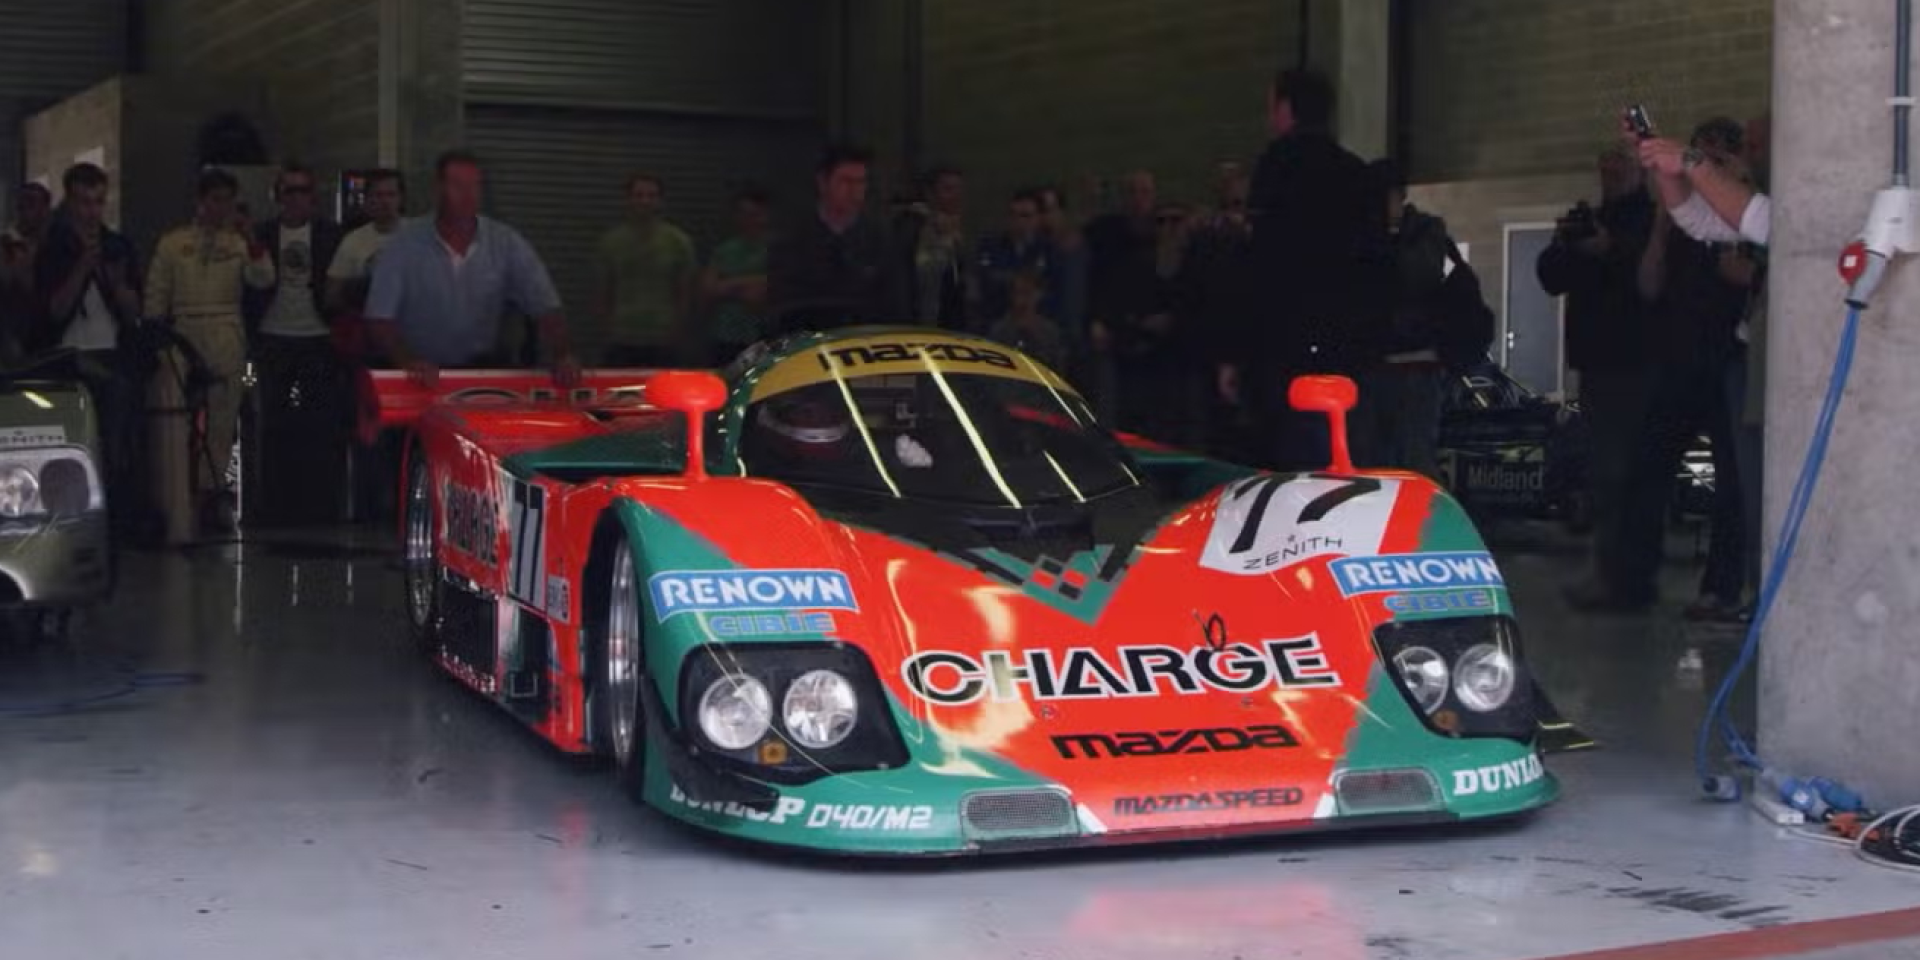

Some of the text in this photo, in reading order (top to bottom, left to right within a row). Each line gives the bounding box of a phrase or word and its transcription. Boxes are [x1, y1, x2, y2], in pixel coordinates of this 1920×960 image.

[1467, 459, 1544, 490] Midland
[1229, 472, 1382, 554] 77
[514, 479, 544, 603] 77
[1243, 535, 1342, 570] ZENITH
[1343, 556, 1503, 588] RENOWN
[660, 575, 848, 607] RENOWN
[1383, 589, 1493, 613] CIBIE
[709, 612, 837, 636] CIBIE
[901, 631, 1342, 706] CHARGE
[1050, 724, 1302, 760] mazda
[805, 803, 933, 829] D40/M2
[1113, 786, 1303, 816] MAZDASPEED
